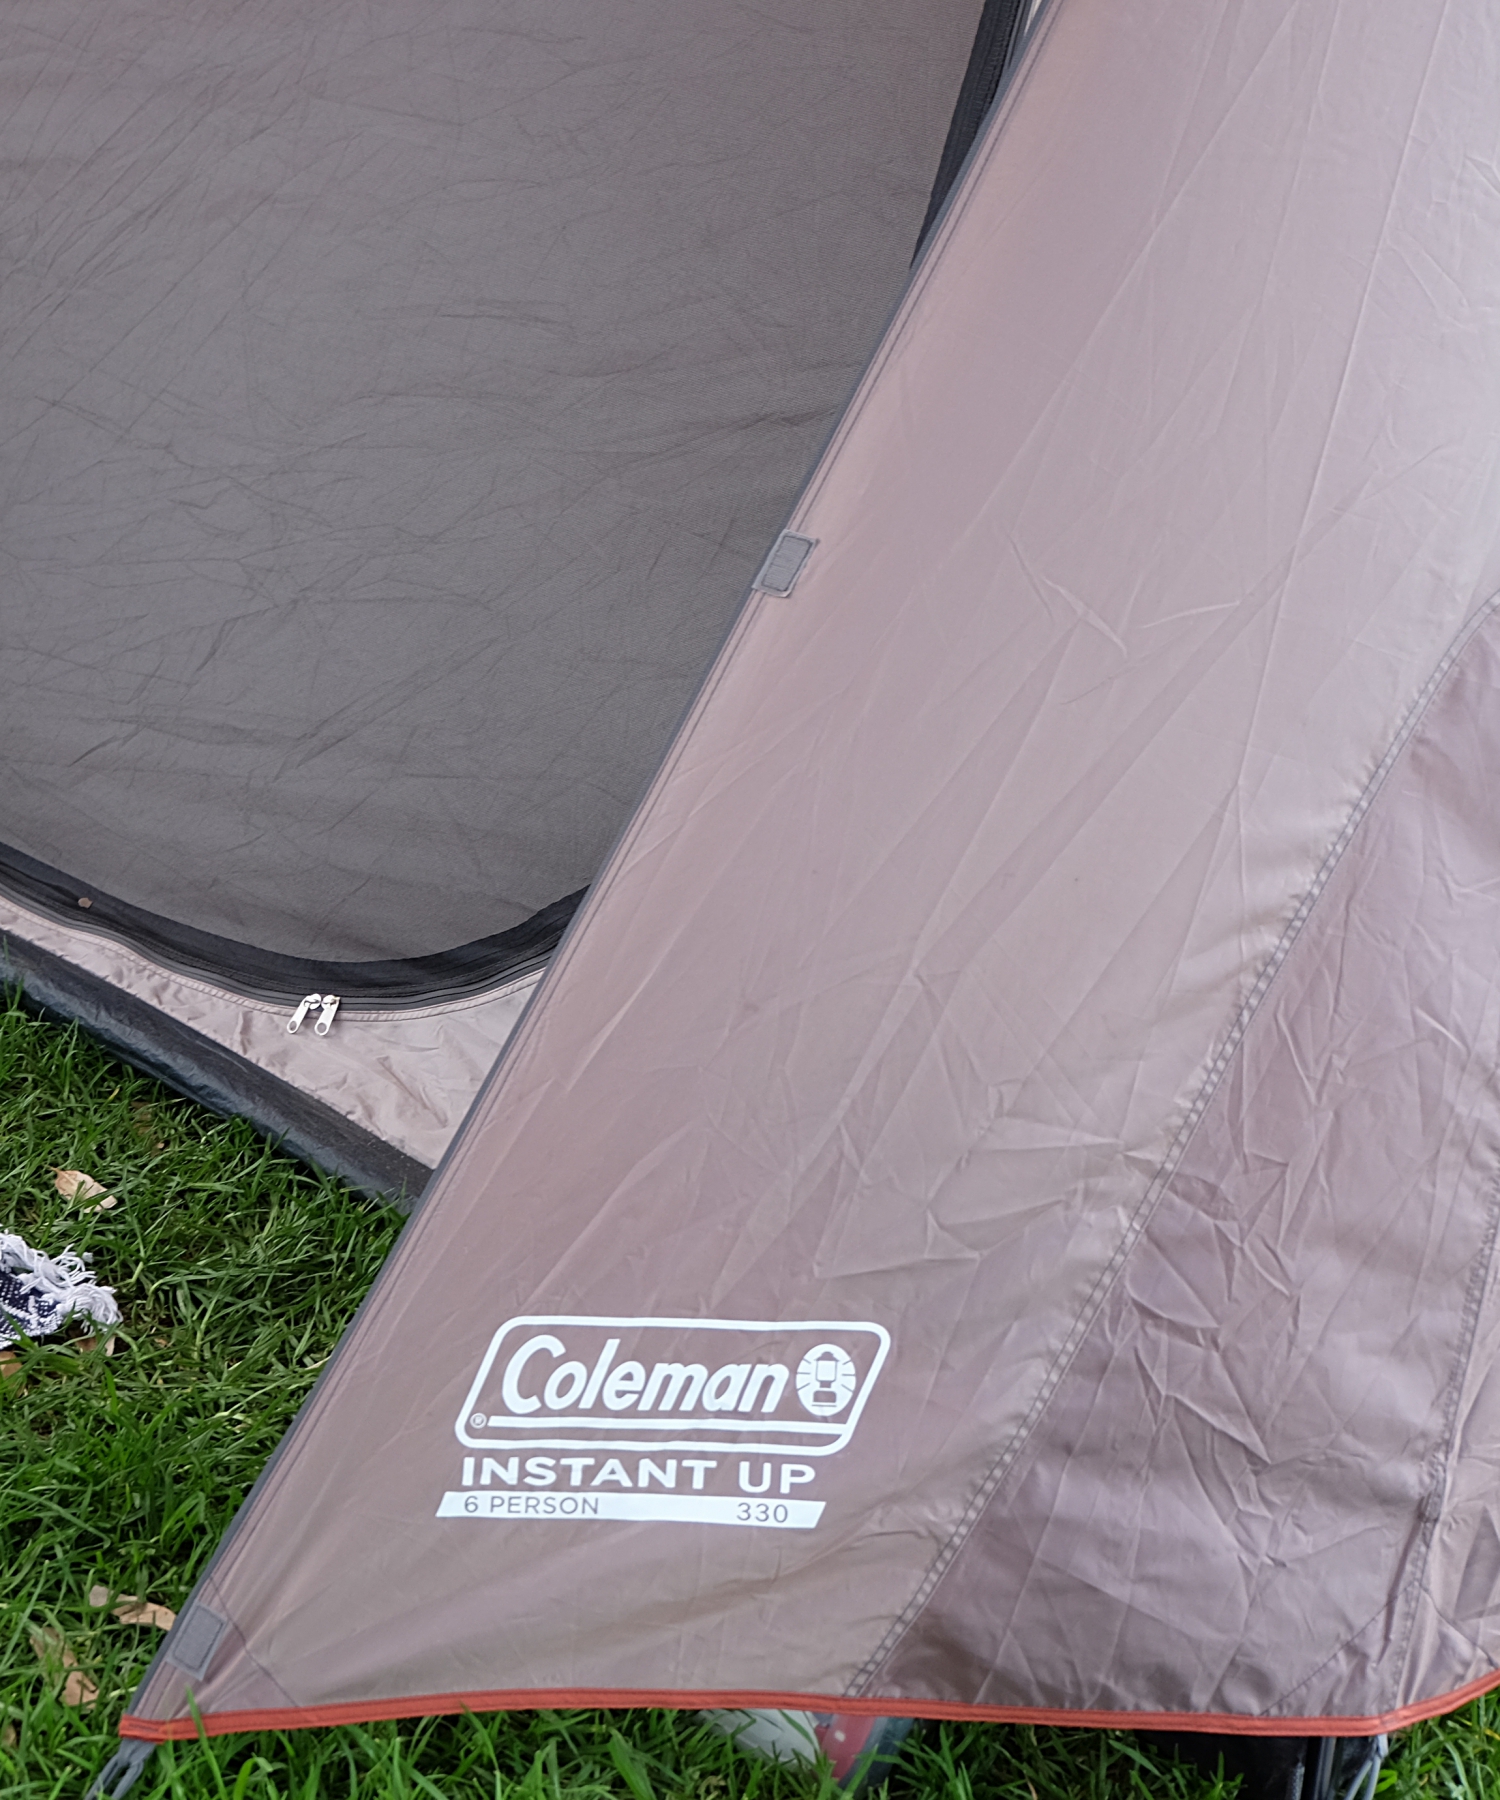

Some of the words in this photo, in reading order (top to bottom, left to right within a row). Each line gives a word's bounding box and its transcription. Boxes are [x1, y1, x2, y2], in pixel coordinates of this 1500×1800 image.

[502, 1333, 790, 1415] Coleman
[462, 1456, 717, 1491] INSTANT
[739, 1462, 817, 1494] UP
[464, 1495, 479, 1514] 6
[490, 1496, 599, 1516] PERSON
[736, 1502, 789, 1524] 330
